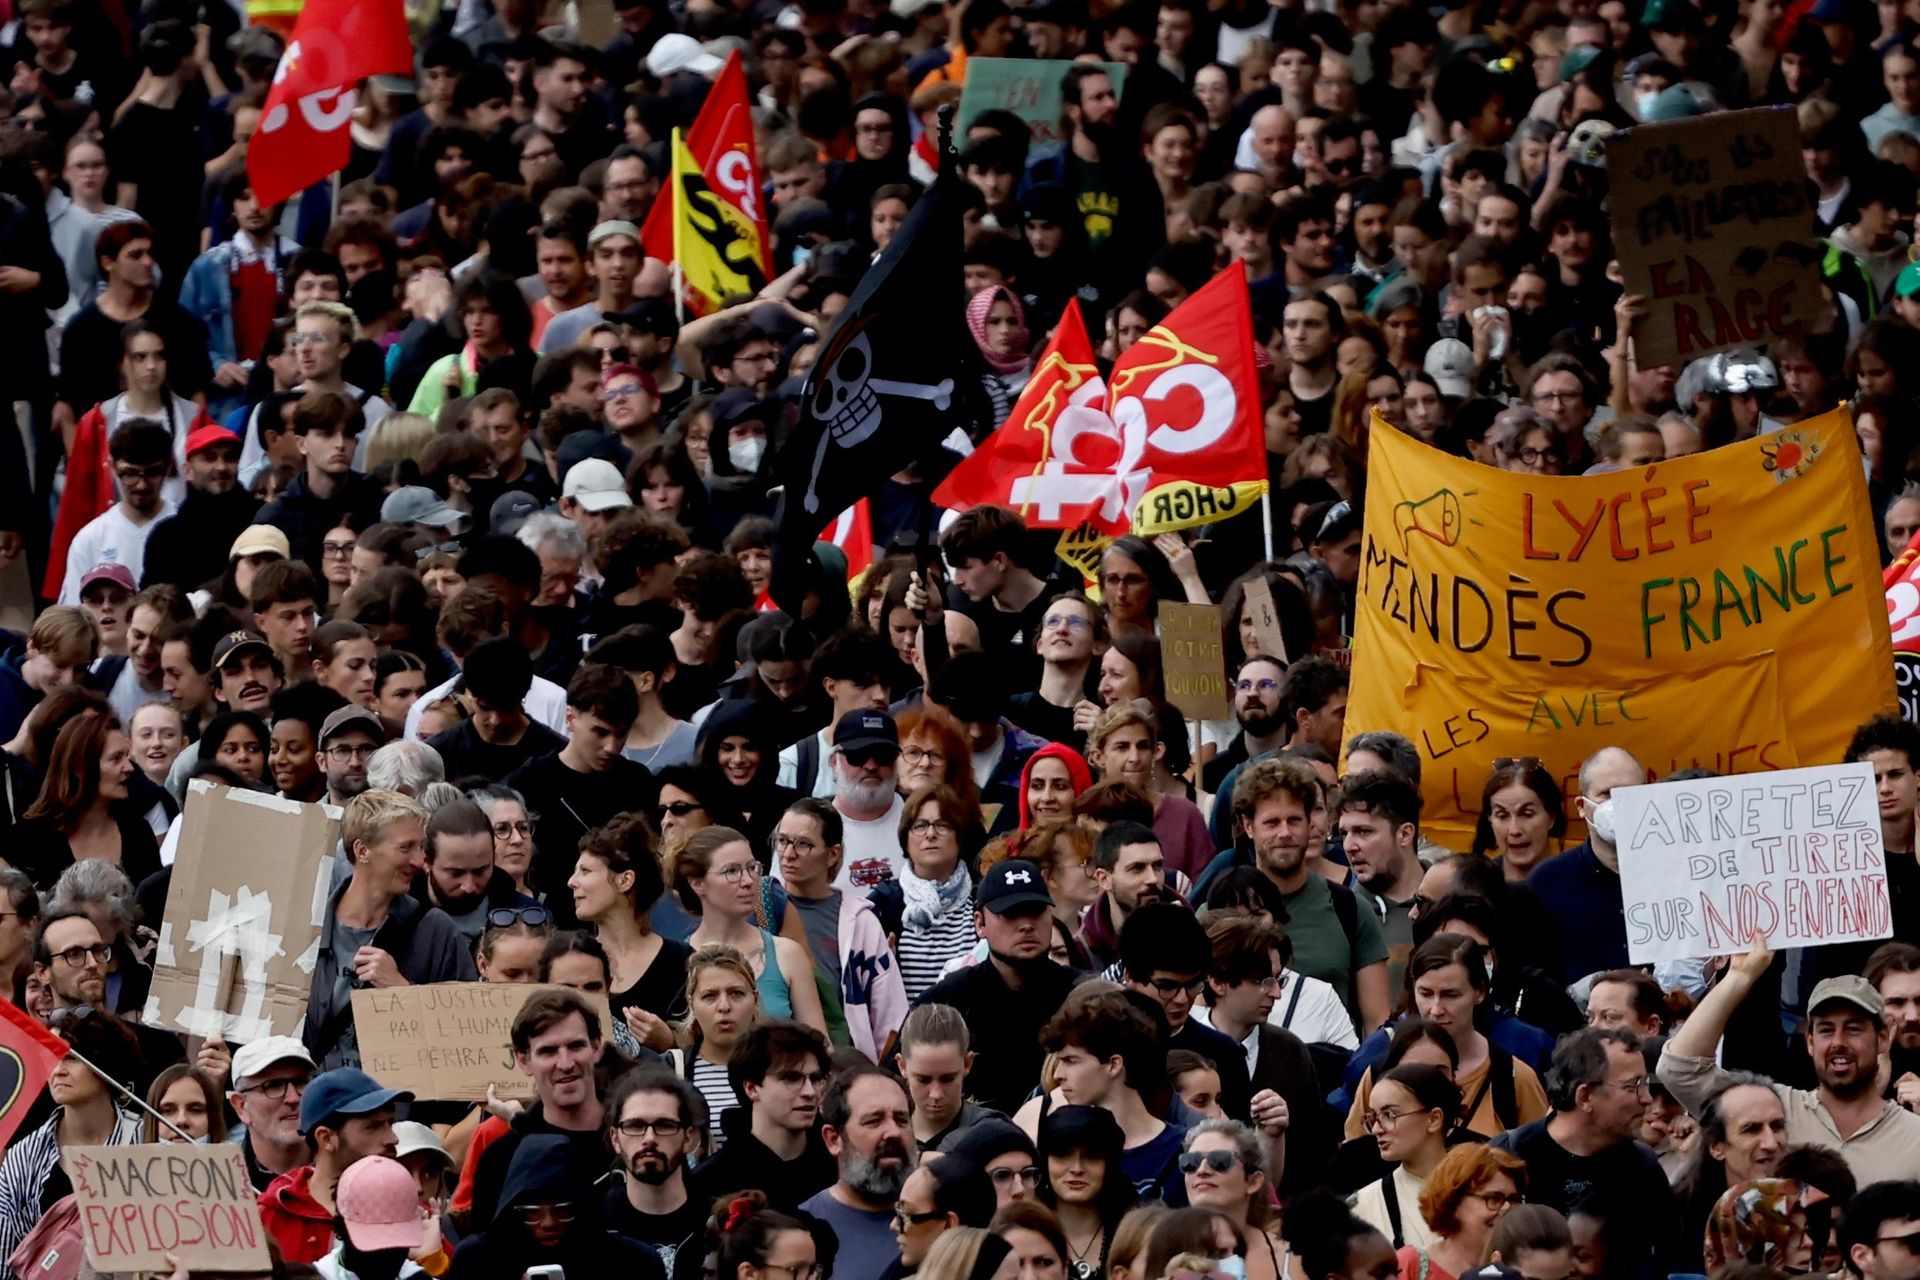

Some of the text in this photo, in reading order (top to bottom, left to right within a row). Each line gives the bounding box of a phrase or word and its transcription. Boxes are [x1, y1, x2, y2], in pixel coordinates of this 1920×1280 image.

[1674, 279, 1803, 355] RAGE
[1521, 466, 1714, 562] LYCÉE
[1363, 533, 1593, 668] MENDÈS
[1640, 523, 1854, 660] FRANCE
[1421, 708, 1491, 761] LES
[1526, 690, 1650, 733] AVEC
[1630, 776, 1868, 850] ARRETEZ
[1688, 828, 1882, 881] DE TIRER
[1626, 872, 1889, 949] SUR NOS ENFANTS
[371, 987, 516, 1014] LA JUSTICE
[389, 1014, 513, 1040] PAR L'HUMA
[373, 1054, 401, 1073] NE
[96, 1156, 238, 1201] MACRON
